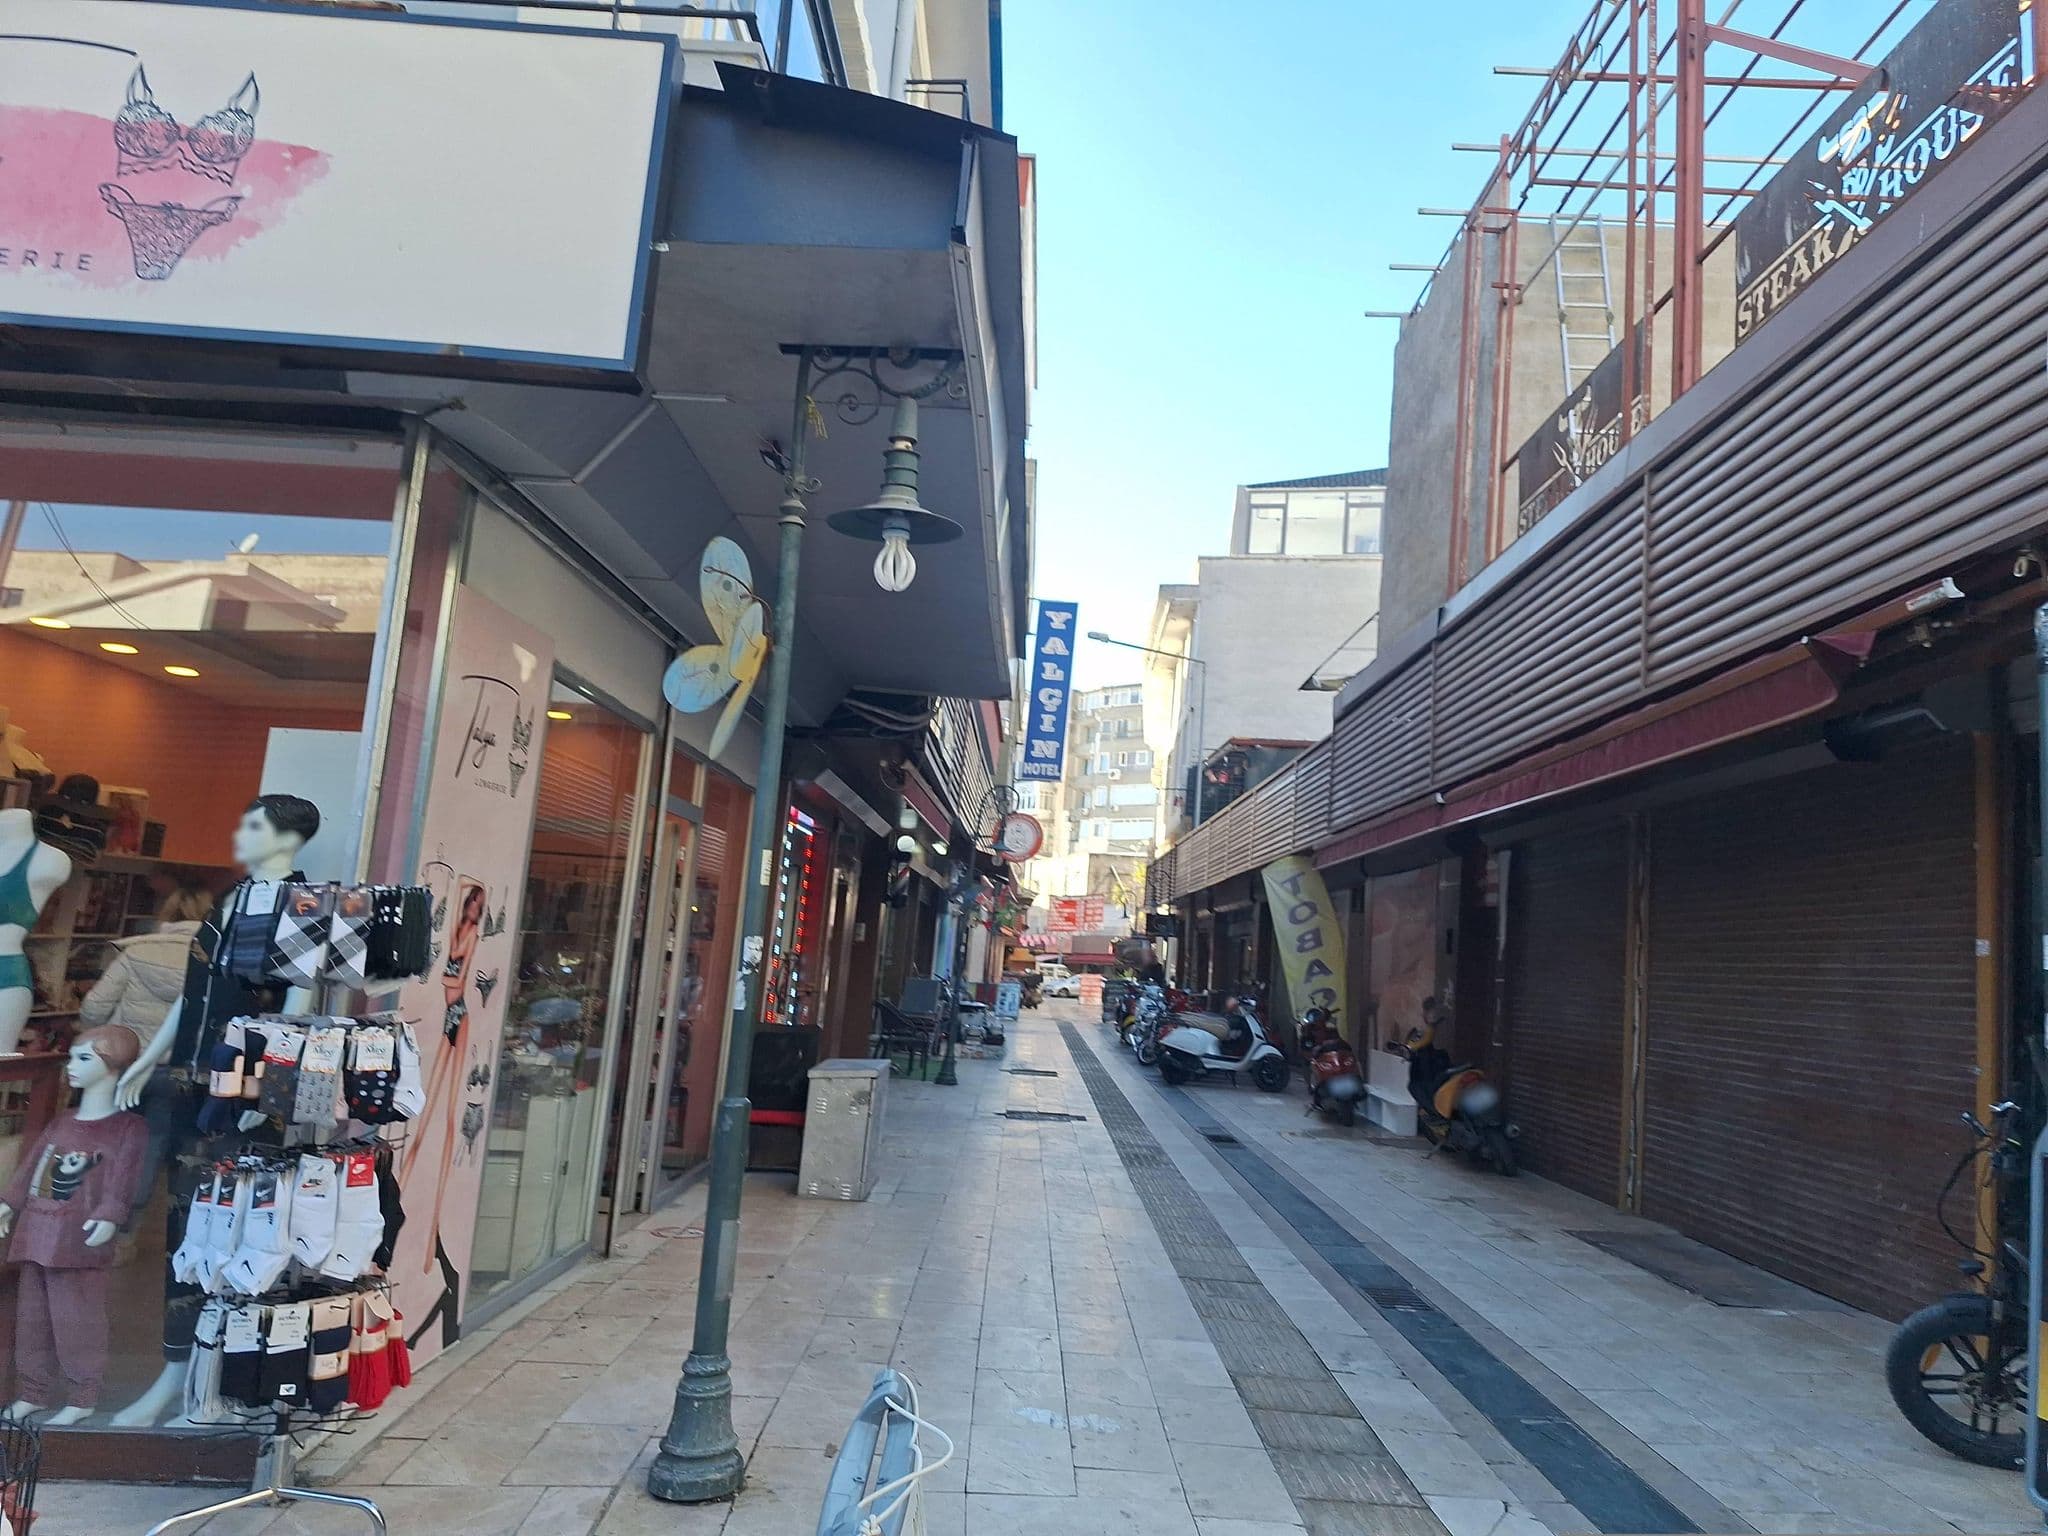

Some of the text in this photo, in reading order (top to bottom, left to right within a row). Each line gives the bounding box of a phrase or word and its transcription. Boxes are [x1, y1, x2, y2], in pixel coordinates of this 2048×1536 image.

[1738, 220, 1836, 338] STEAK
[1031, 610, 1073, 759] YALÇIN
[1023, 762, 1062, 777] HOTEL
